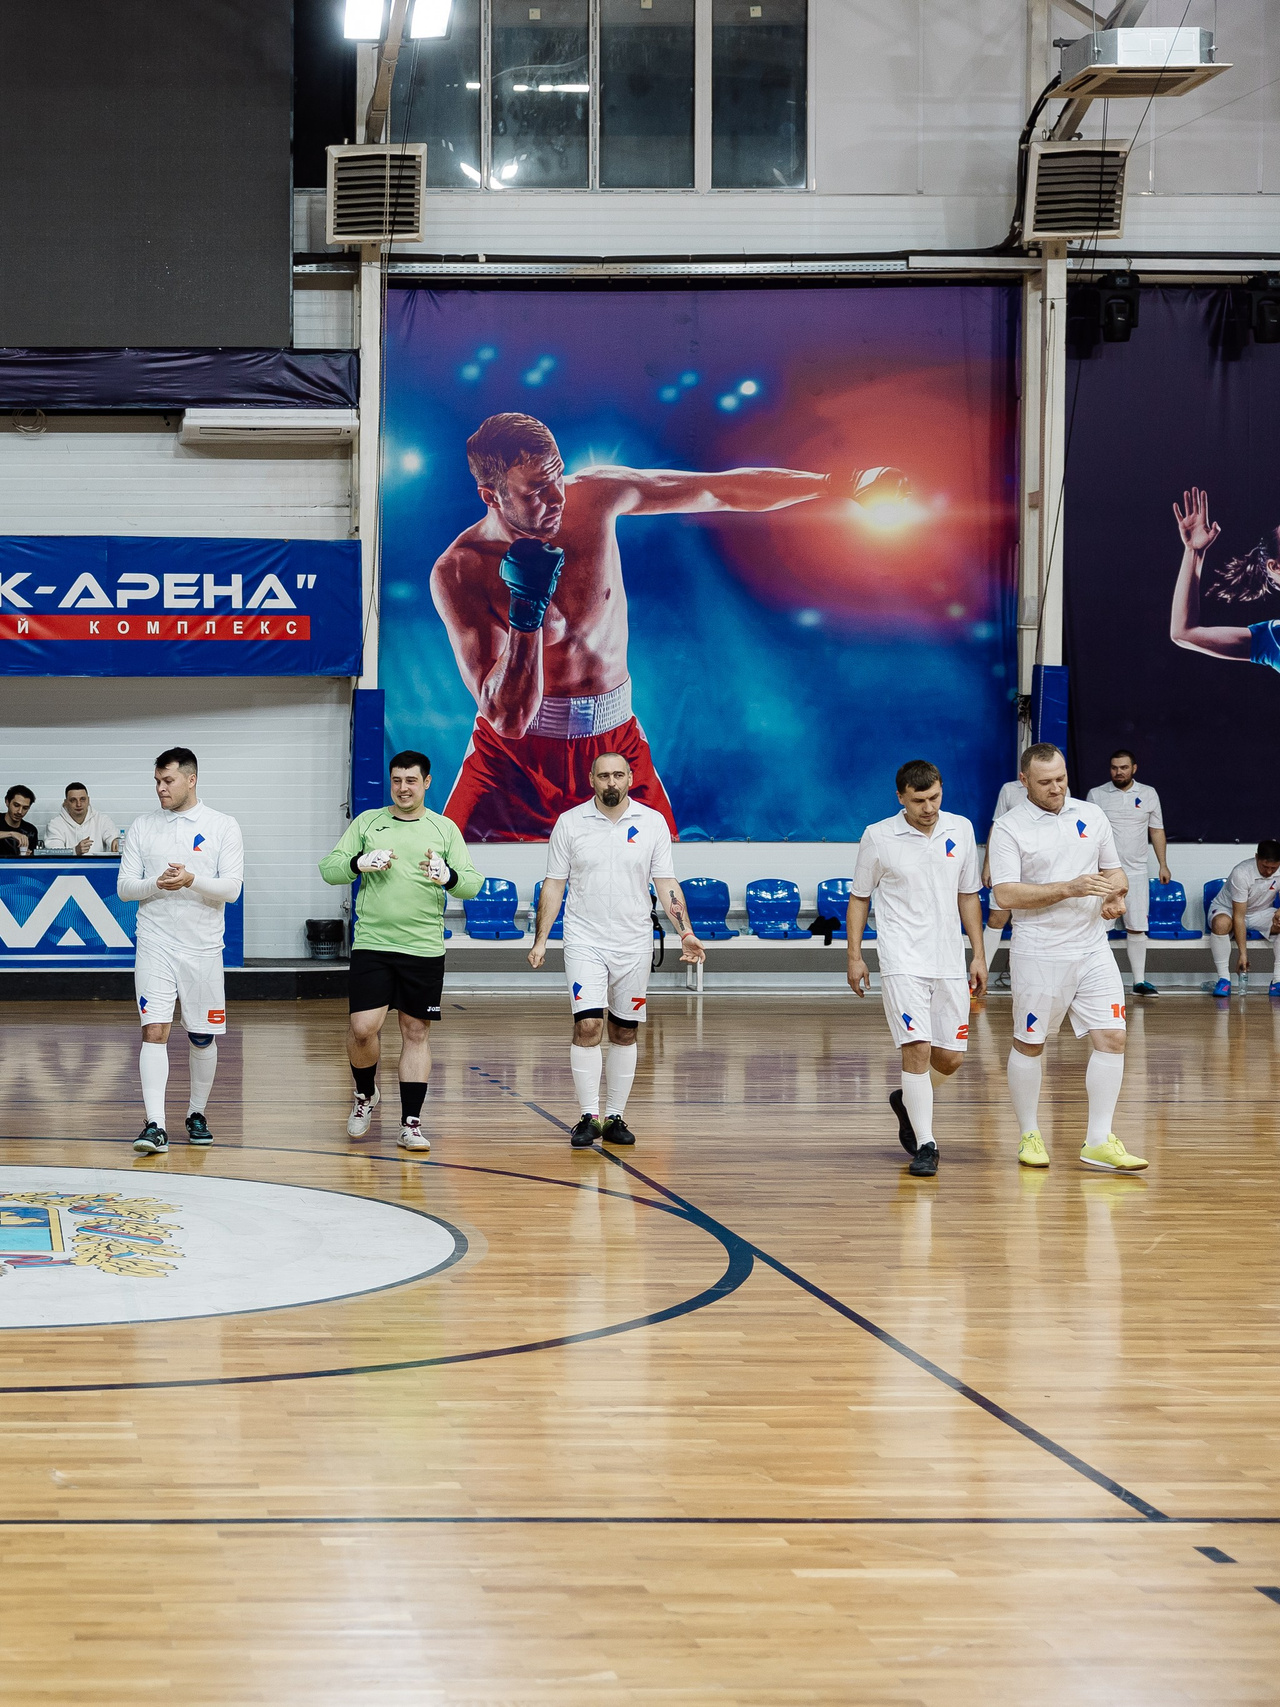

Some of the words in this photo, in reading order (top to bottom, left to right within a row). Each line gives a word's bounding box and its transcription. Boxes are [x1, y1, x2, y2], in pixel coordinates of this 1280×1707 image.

[89, 620, 298, 635] КОМПЛЕКС
[631, 997, 646, 1011] 7
[207, 1009, 225, 1025] 5
[956, 1024, 969, 1040] 2
